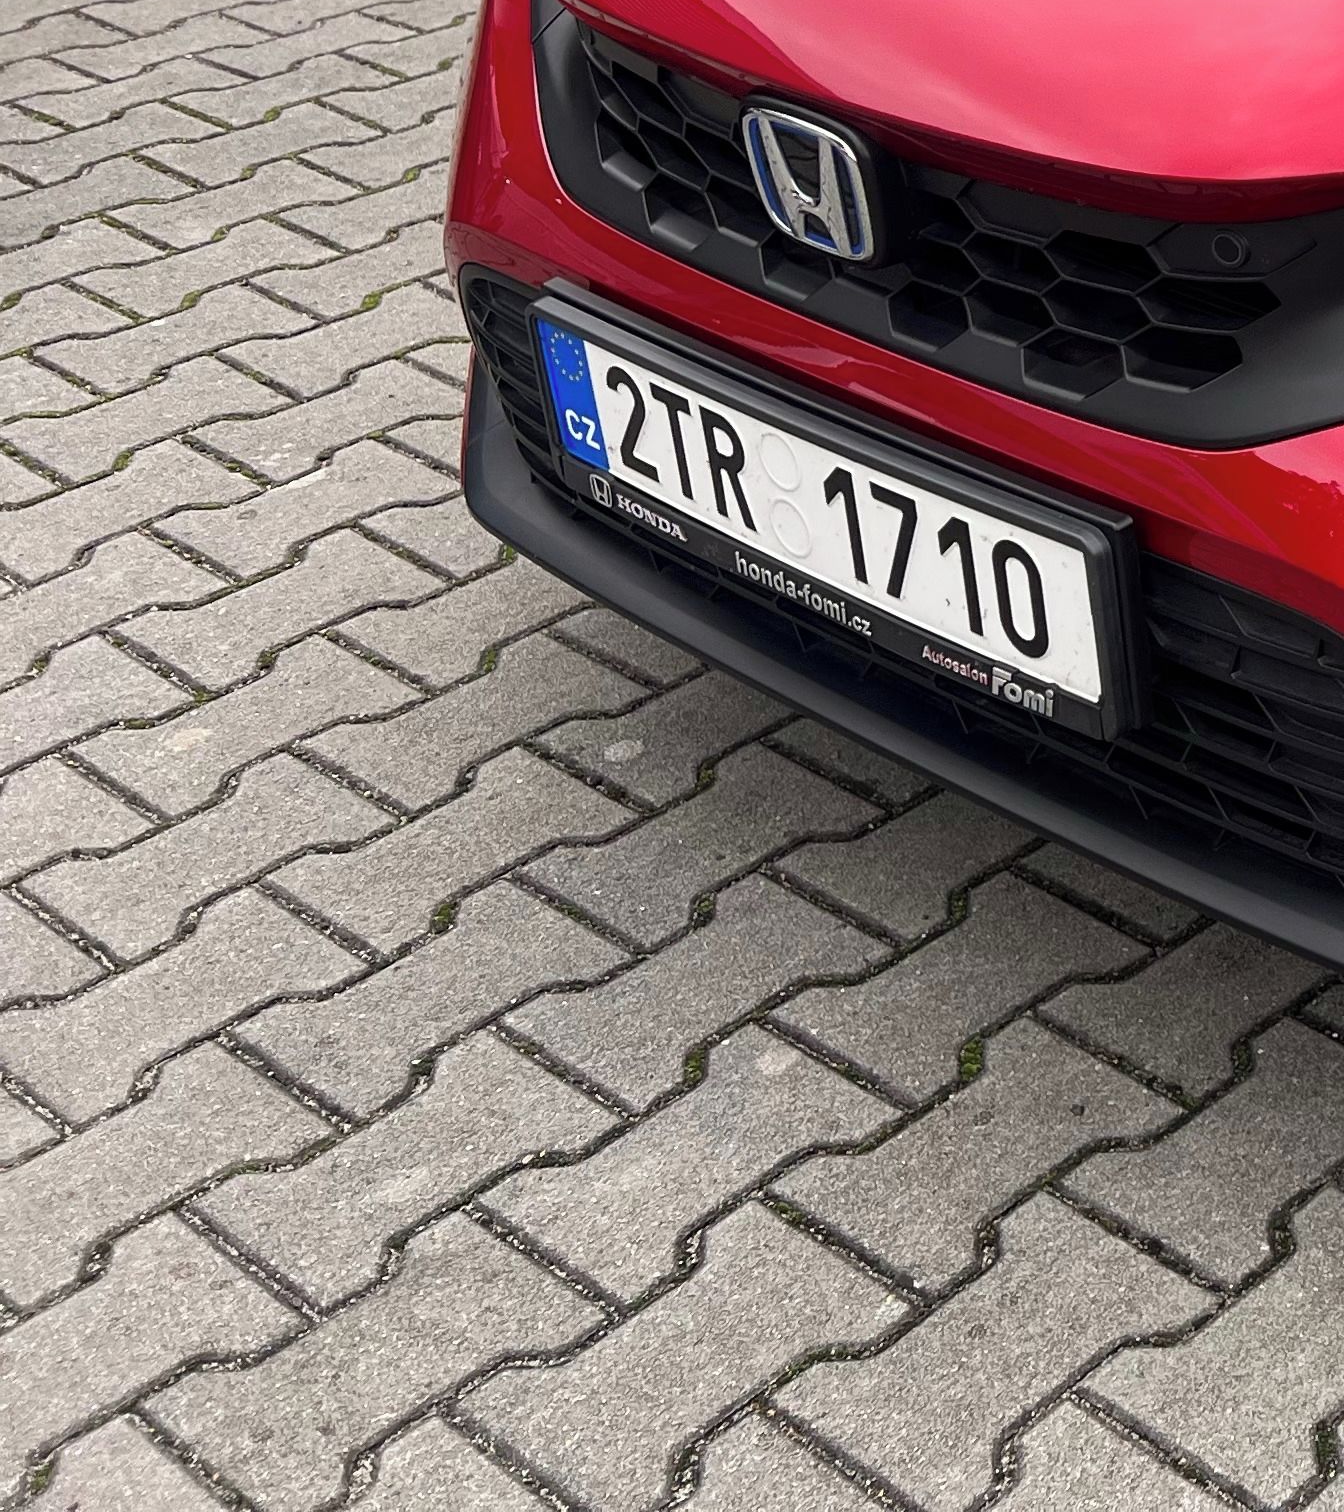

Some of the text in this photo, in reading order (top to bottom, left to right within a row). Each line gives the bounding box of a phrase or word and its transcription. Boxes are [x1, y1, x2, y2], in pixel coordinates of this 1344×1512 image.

[565, 408, 601, 451] CZ
[606, 365, 1050, 658] 2TR 1710
[616, 493, 688, 542] HONDA
[734, 551, 872, 637] honda-fomi.cz
[922, 645, 1054, 718] Autosalon Fomi
